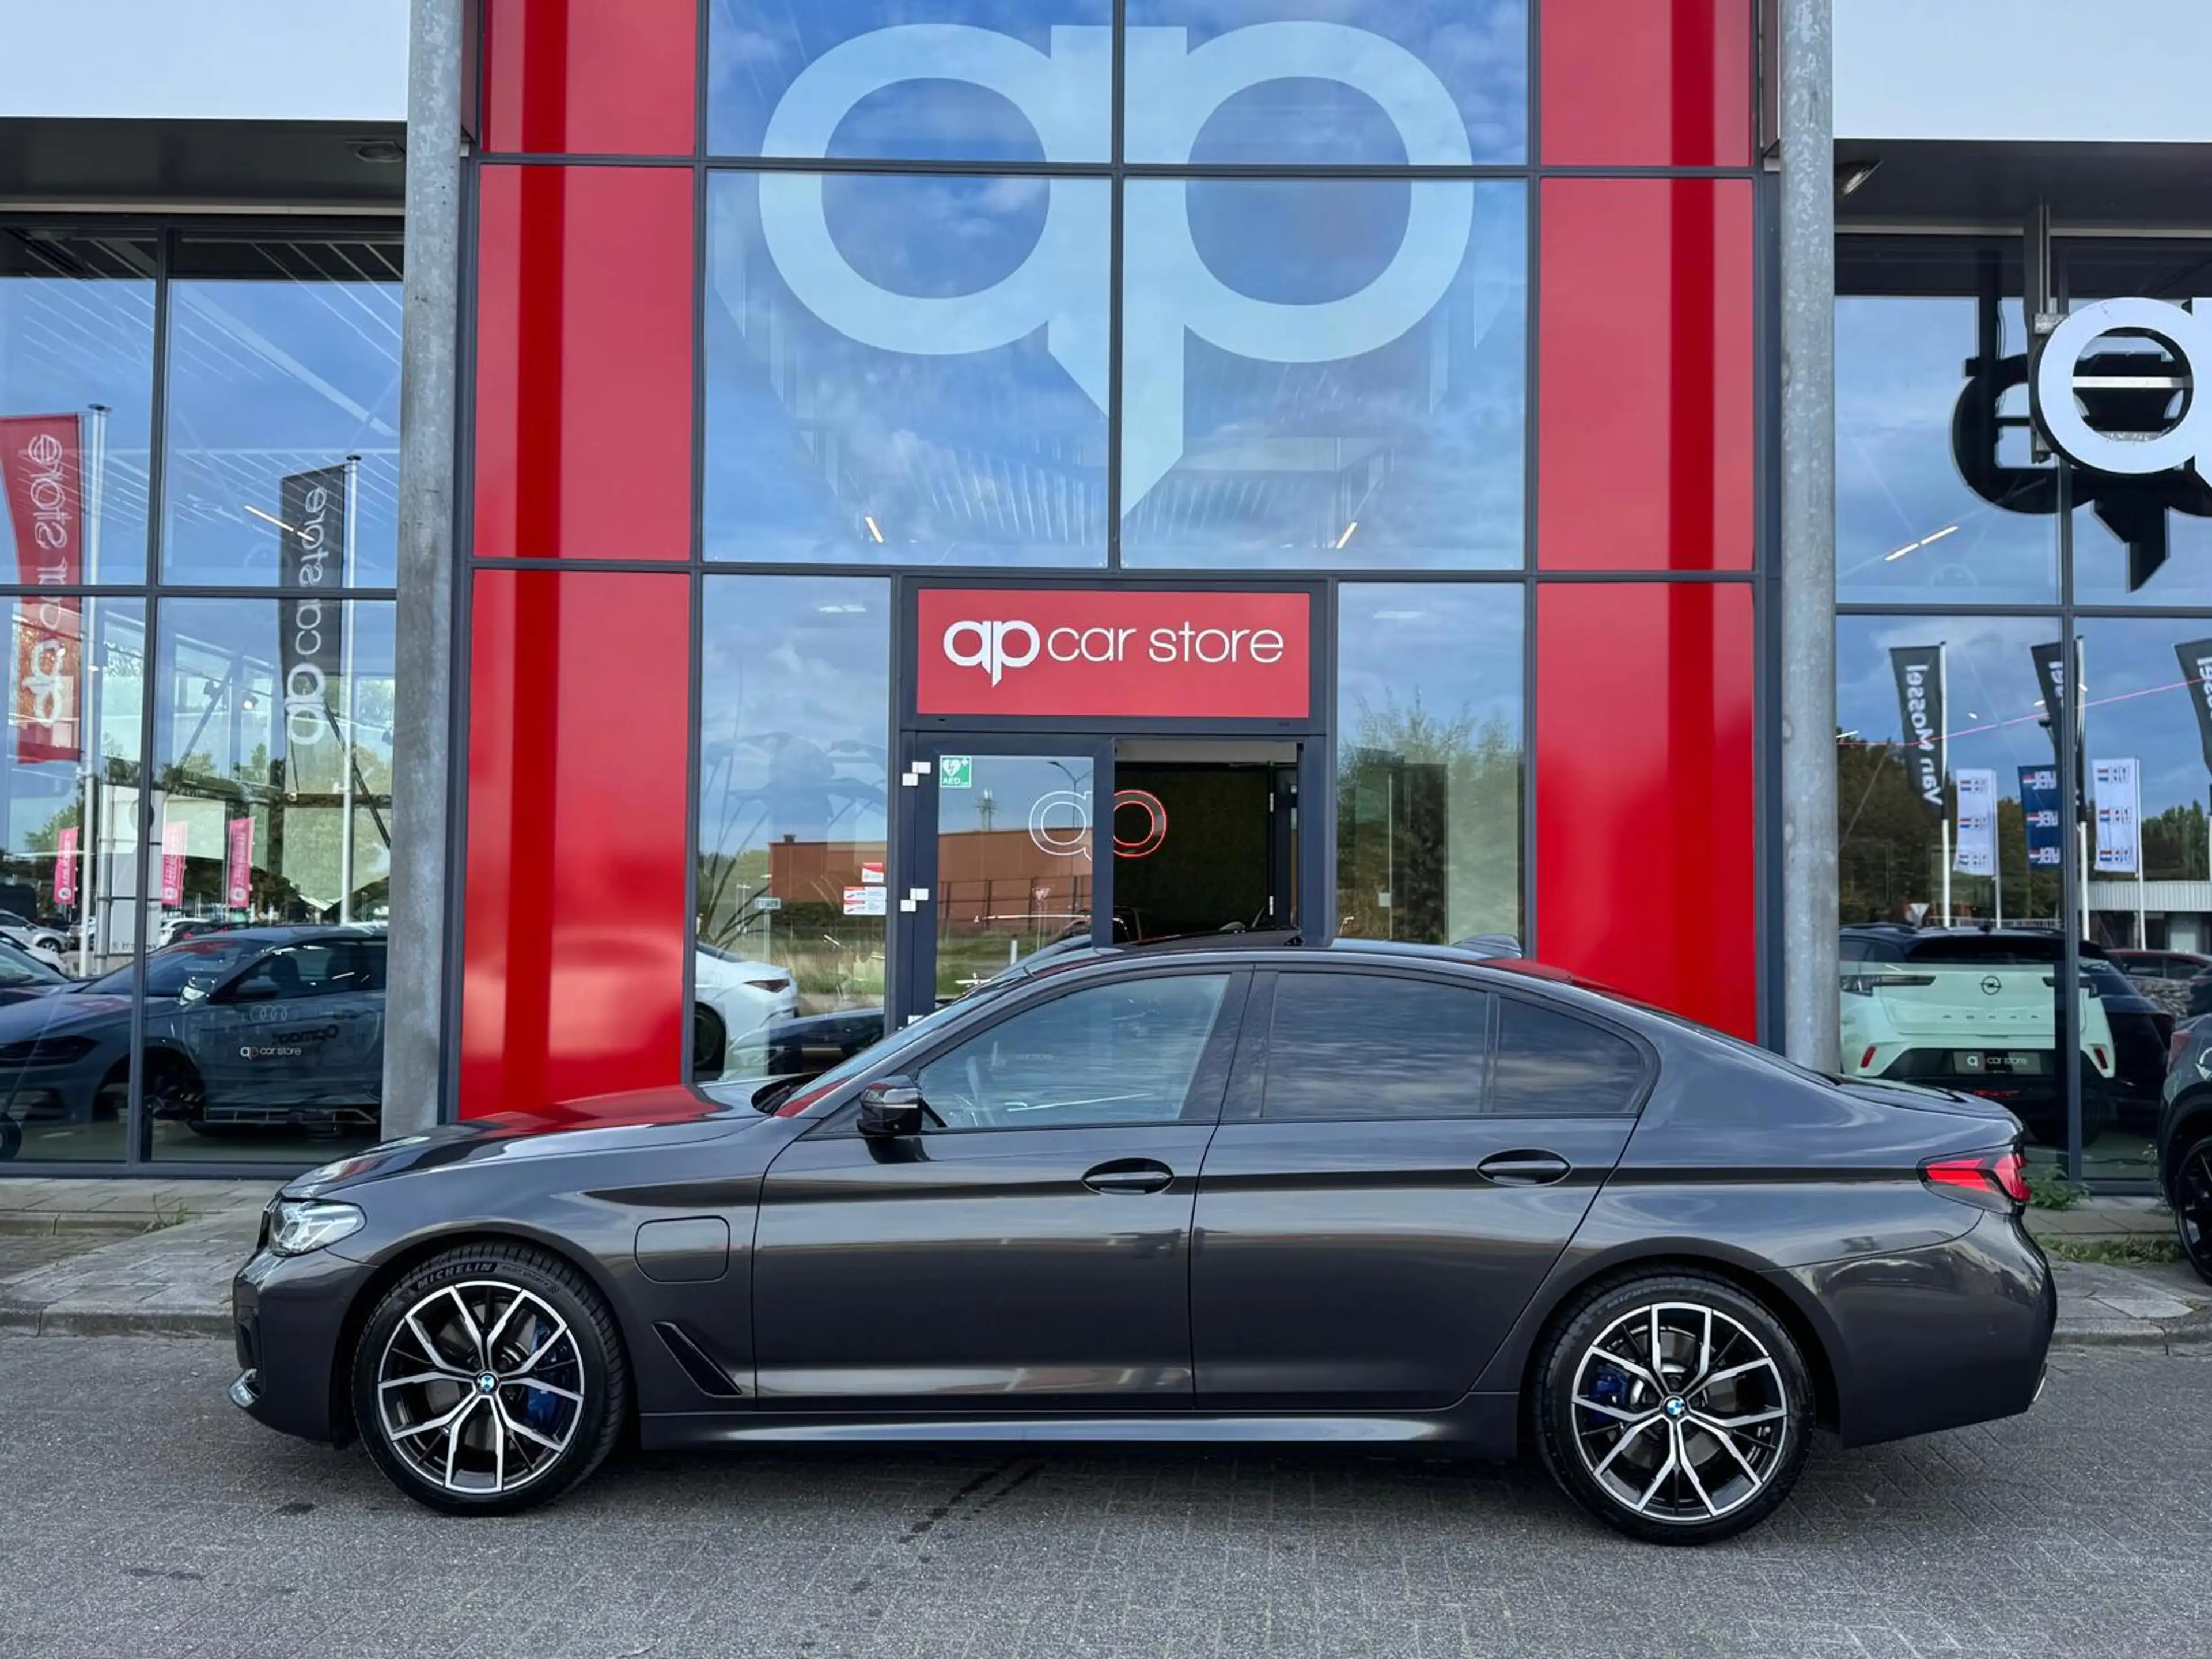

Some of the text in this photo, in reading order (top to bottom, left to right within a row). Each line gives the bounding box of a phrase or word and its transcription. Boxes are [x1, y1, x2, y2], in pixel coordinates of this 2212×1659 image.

[759, 21, 1474, 517] ap
[943, 620, 1283, 687] ap car store
[942, 777, 961, 785] AED
[417, 1262, 494, 1291] MICHELIN
